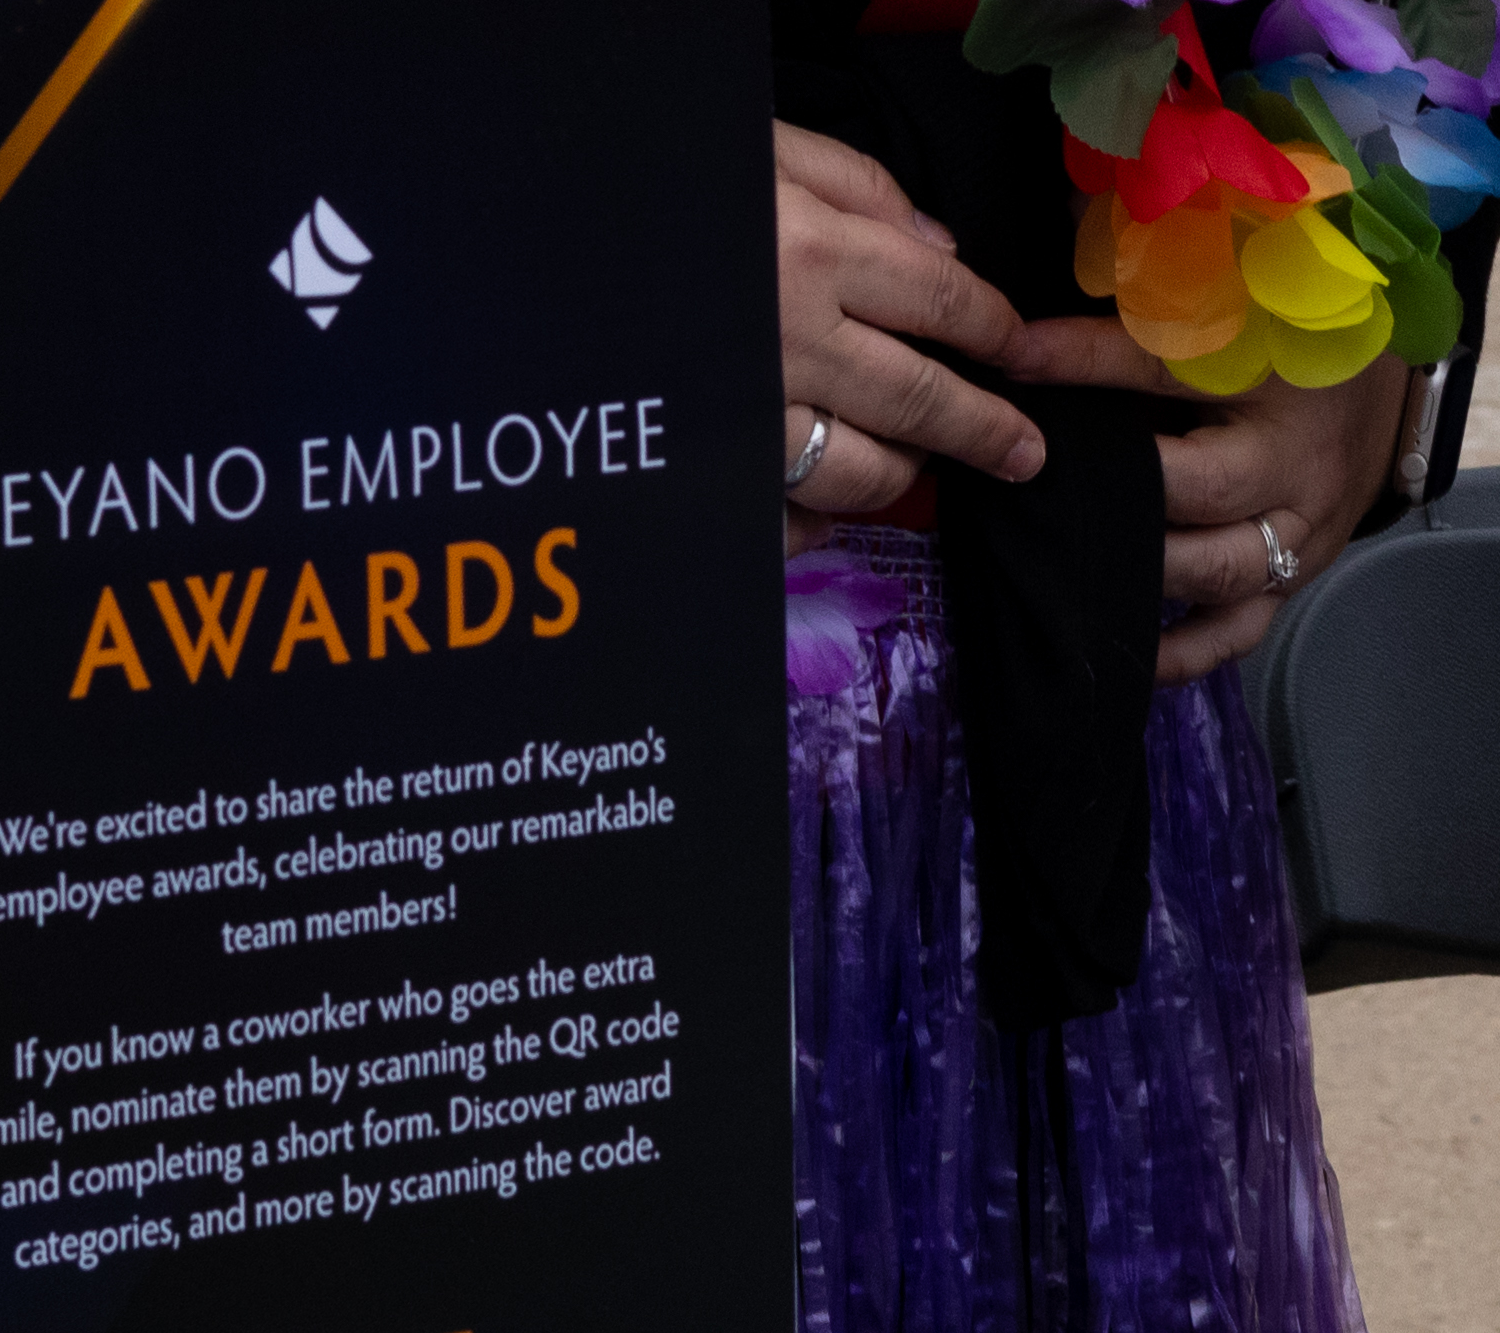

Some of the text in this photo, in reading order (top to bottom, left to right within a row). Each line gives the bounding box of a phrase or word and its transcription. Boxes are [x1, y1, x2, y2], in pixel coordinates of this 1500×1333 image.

[300, 398, 666, 511] EMPLOYEE
[69, 527, 581, 699] AWARDS
[95, 788, 207, 843] excited
[214, 795, 248, 826] to
[256, 779, 337, 821] share
[343, 766, 394, 808] the
[401, 761, 494, 799] return
[501, 741, 536, 785] of
[541, 726, 666, 786] Keyano's
[152, 846, 267, 898] awards,
[274, 828, 444, 880] celebrating
[450, 821, 503, 854] our
[511, 785, 675, 845] remarkable
[221, 884, 456, 954] team members!
[15, 954, 655, 1088] If you know a coworker who goes the extra
[71, 1084, 217, 1133] nominate
[223, 1067, 302, 1109] them
[310, 1055, 350, 1104] by
[357, 1040, 487, 1088] scanning
[492, 1024, 542, 1065] the
[549, 1013, 599, 1059] QR
[606, 1000, 680, 1046] code
[0, 1059, 671, 1209] and completing a short form. Discover award
[14, 1126, 660, 1271] categories, and more by scanning the code.
